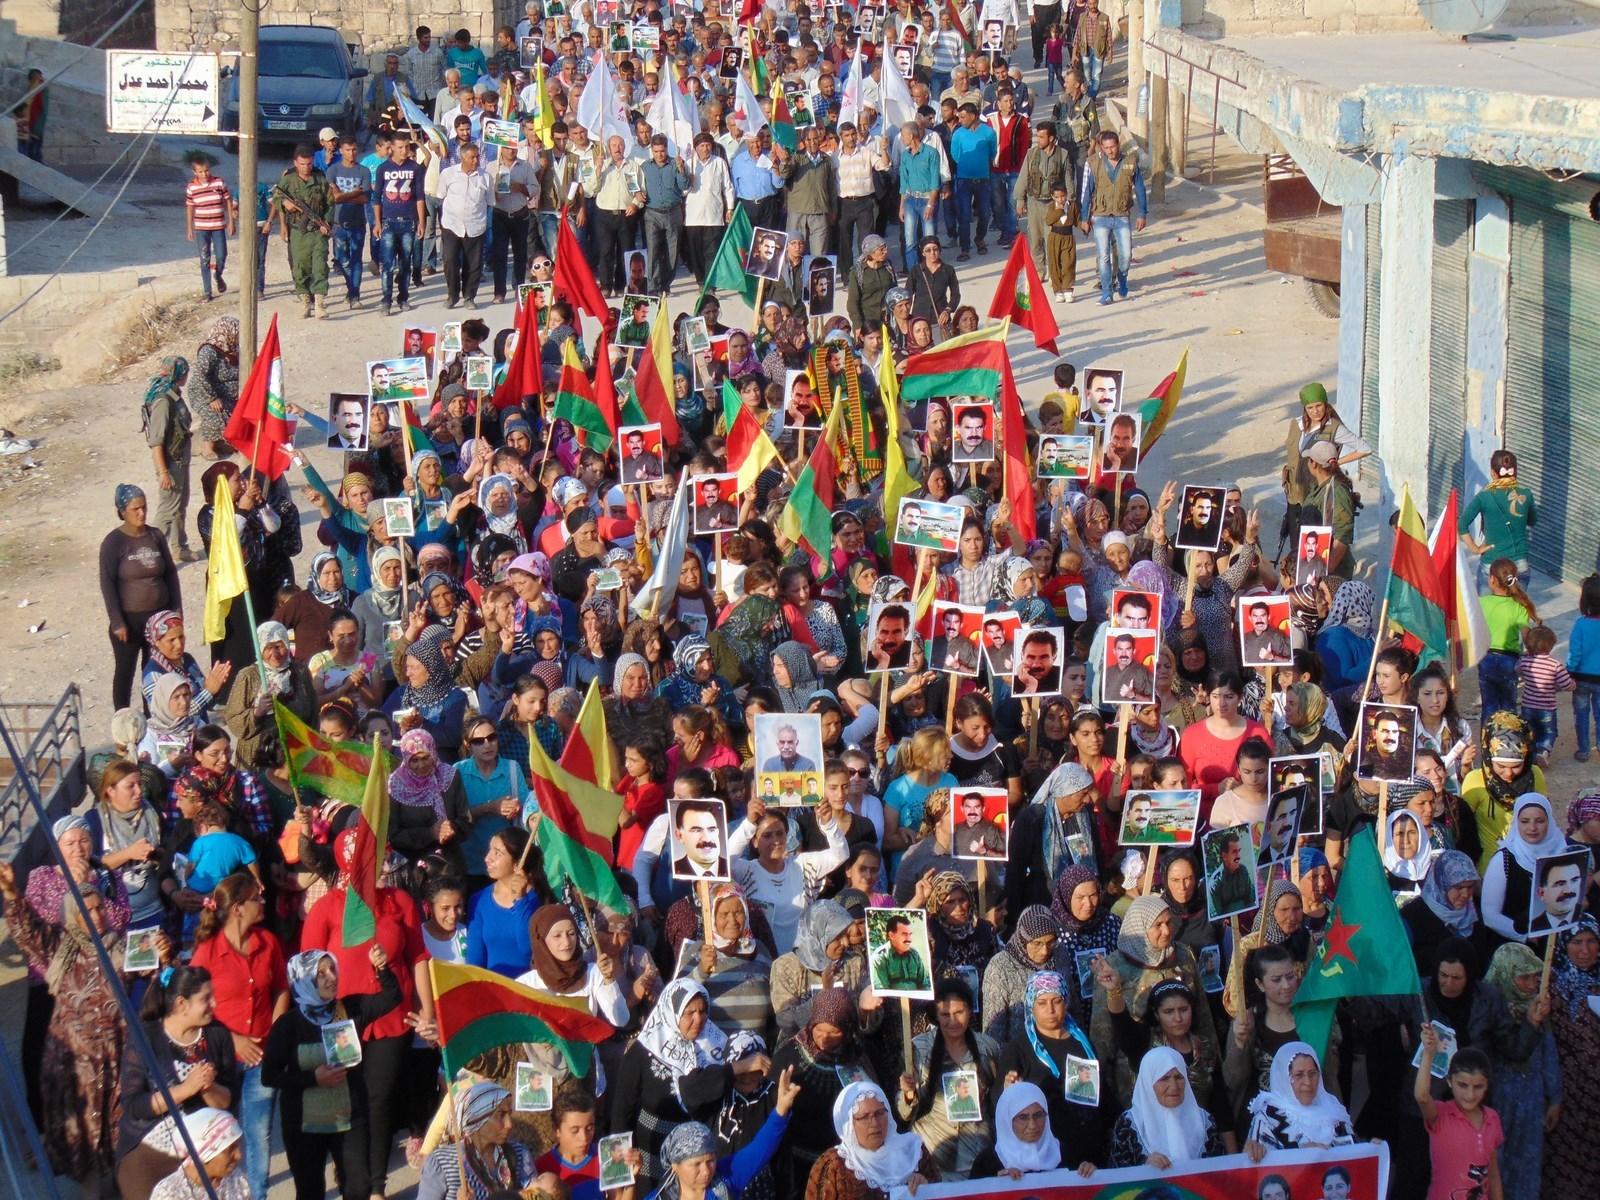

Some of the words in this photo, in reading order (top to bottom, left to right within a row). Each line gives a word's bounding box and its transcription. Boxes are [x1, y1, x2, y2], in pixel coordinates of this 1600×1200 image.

[144, 57, 186, 67] الدكتور
[119, 72, 143, 91] عدل
[176, 79, 209, 91] محمد
[384, 170, 414, 180] ROUTE
[385, 179, 412, 200] 66
